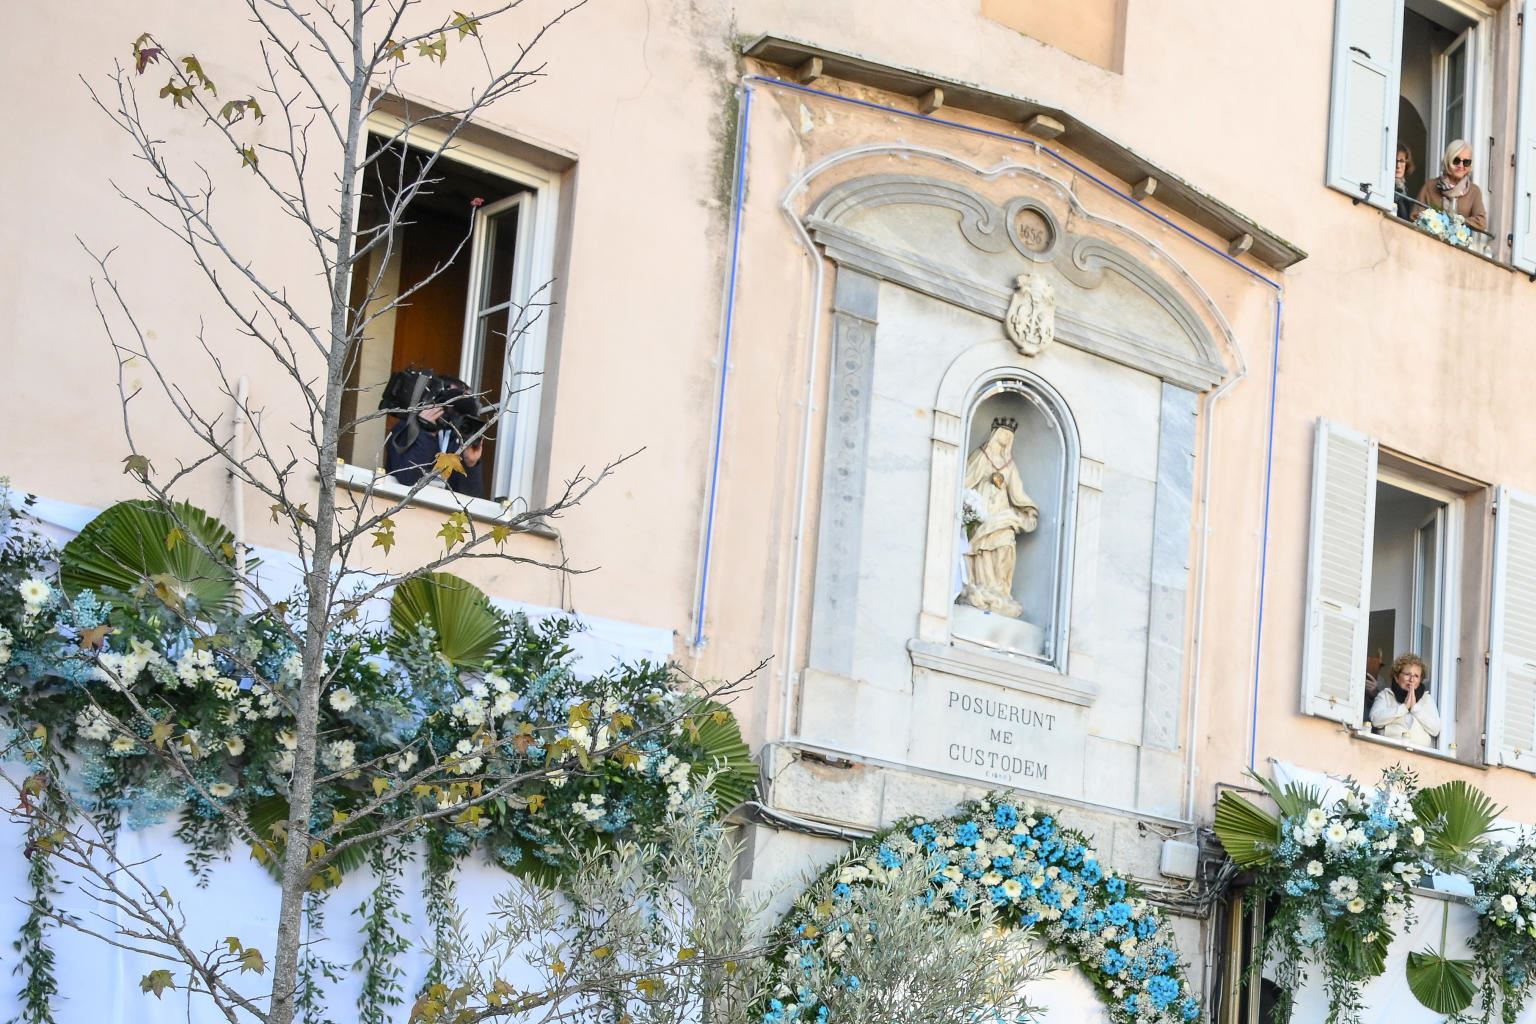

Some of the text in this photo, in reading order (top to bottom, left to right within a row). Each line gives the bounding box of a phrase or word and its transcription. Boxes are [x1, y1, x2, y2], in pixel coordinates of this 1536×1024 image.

[948, 691, 1056, 731] POSUERUNT
[990, 728, 1013, 745] ME
[949, 743, 1048, 780] CUSTODEM
